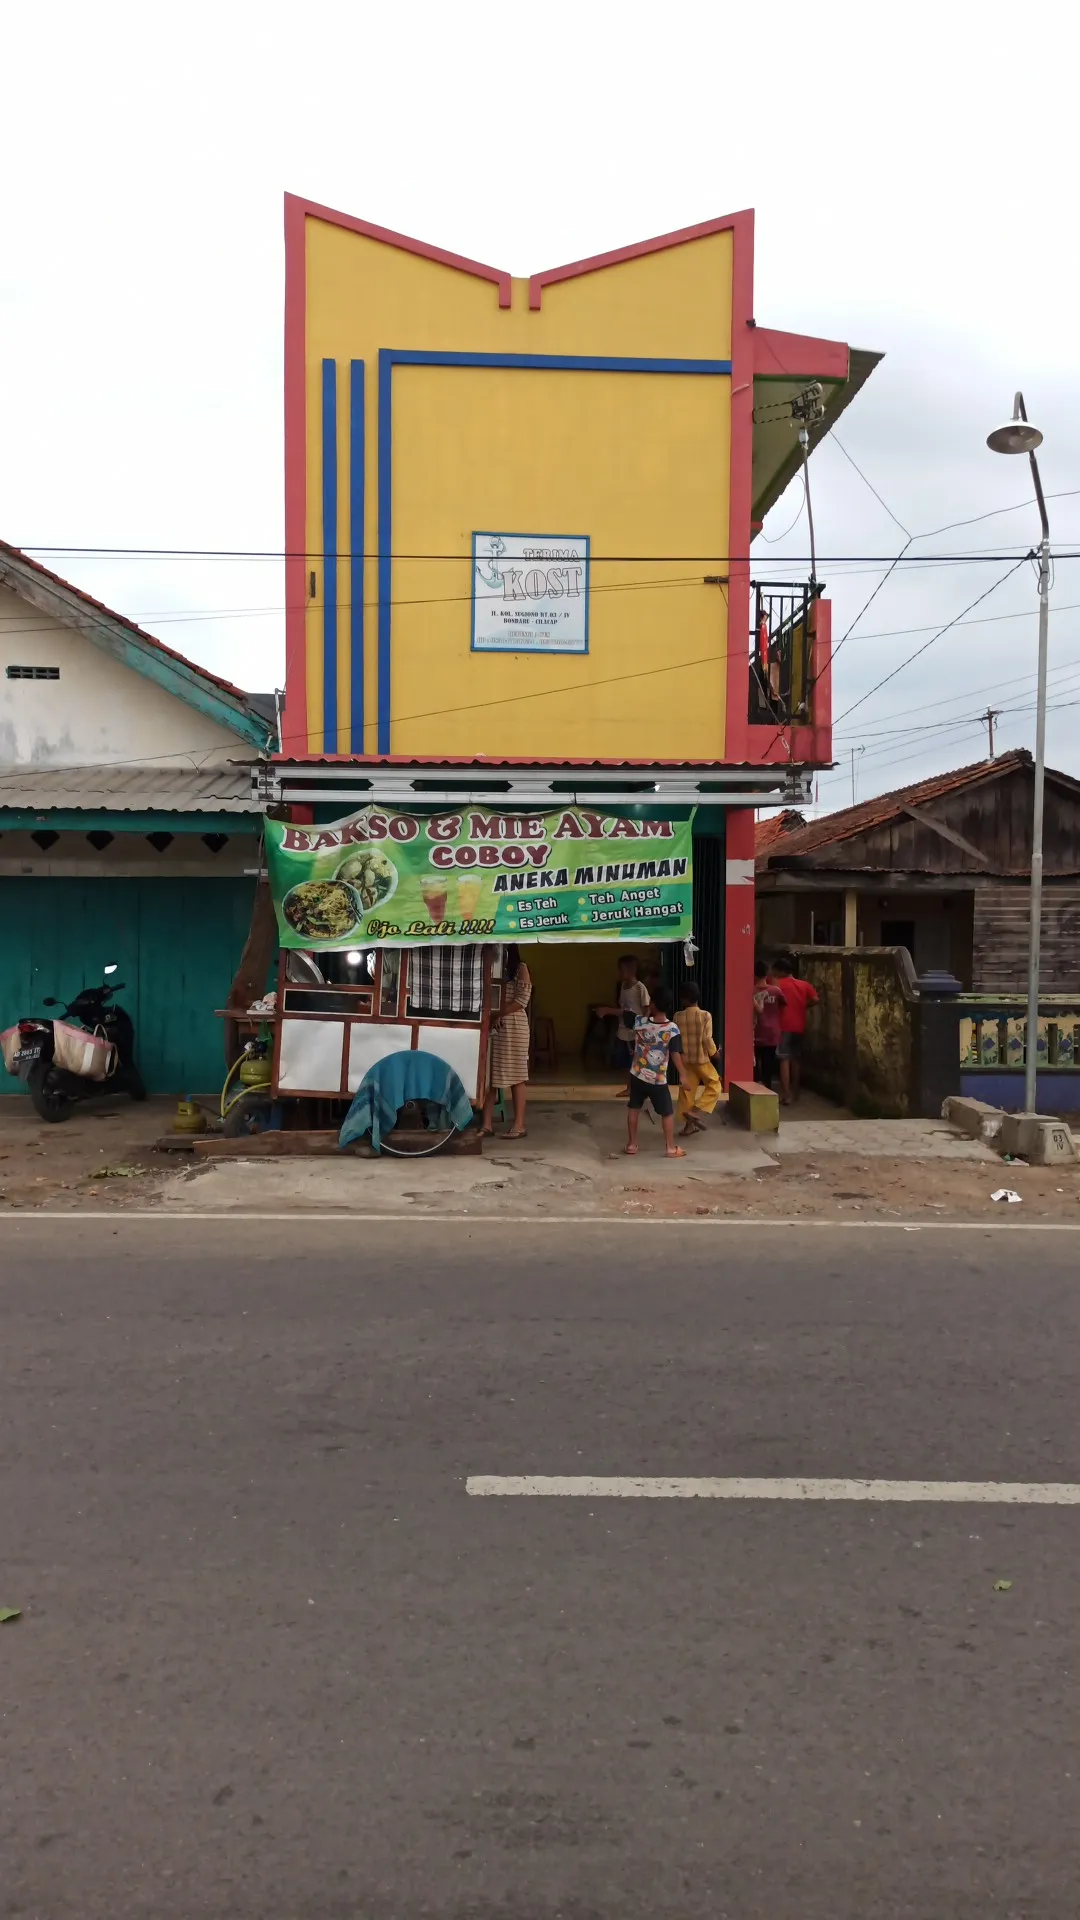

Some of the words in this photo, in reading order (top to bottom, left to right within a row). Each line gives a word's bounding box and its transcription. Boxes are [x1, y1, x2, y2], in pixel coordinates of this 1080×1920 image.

[523, 548, 581, 563] TERIMA
[502, 566, 583, 602] KOST
[281, 814, 419, 852] BAKSO
[426, 814, 462, 842] &
[468, 812, 547, 841] MIE
[552, 811, 675, 840] AYAM
[429, 844, 551, 868] COBOY
[493, 867, 569, 893] ANEKA
[574, 857, 687, 885] MINUMAN
[517, 900, 532, 912] Es
[534, 897, 557, 911] Teh
[589, 892, 615, 905] Teh
[621, 886, 660, 904] Anget
[519, 917, 534, 929] Es
[536, 913, 569, 927] Jeruk
[592, 908, 631, 922] Jeruk
[635, 901, 683, 919] Hangat
[367, 919, 400, 940] Ojo
[405, 920, 456, 936] Lali
[460, 918, 496, 936] !!!!
